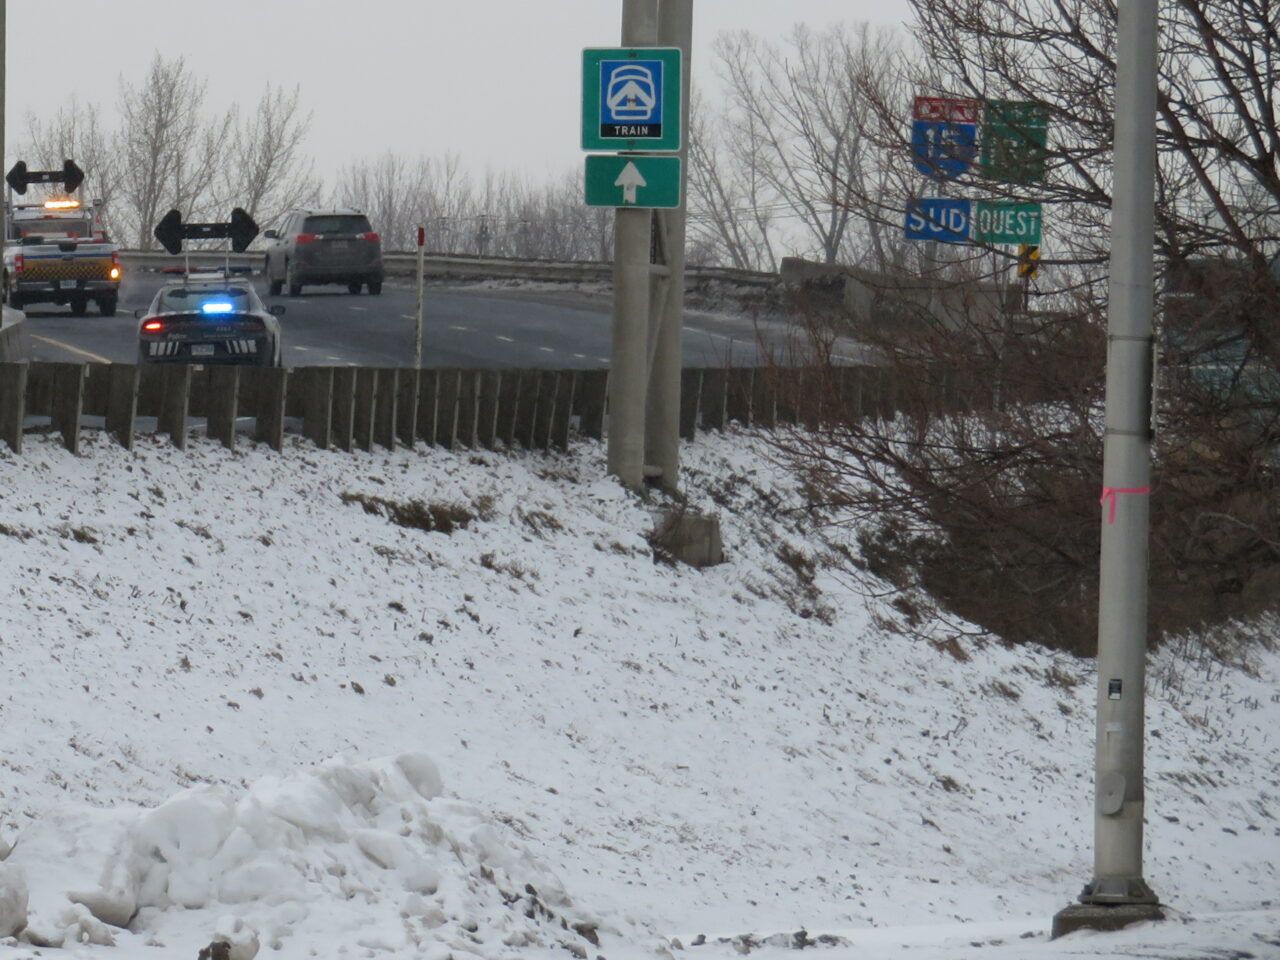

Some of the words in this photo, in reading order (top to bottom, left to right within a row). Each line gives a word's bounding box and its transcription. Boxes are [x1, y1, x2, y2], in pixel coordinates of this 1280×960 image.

[613, 125, 649, 136] TRAIN
[909, 208, 967, 233] SUD
[979, 209, 1040, 236] OUEST
